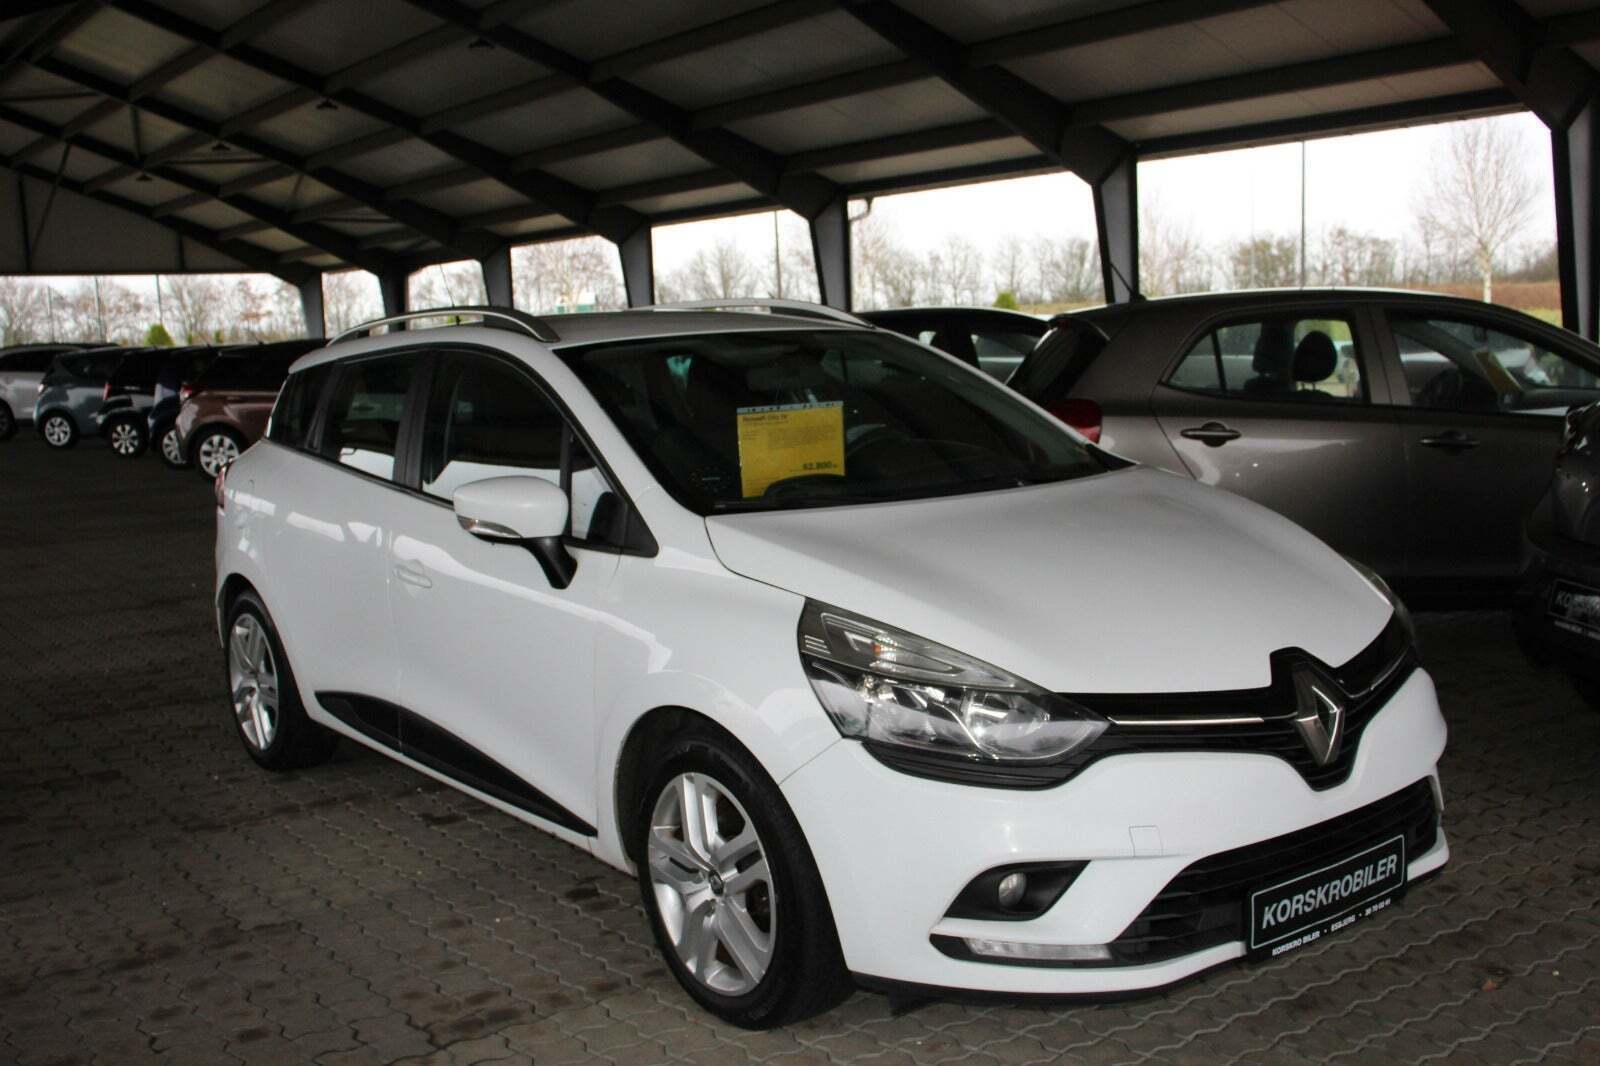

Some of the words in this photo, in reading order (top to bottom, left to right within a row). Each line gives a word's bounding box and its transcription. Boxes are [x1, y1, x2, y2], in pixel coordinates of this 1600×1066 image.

[1262, 854, 1398, 929] KORSKROBILER
[1272, 937, 1302, 956] KORSKRO
[1302, 930, 1321, 944] BILER
